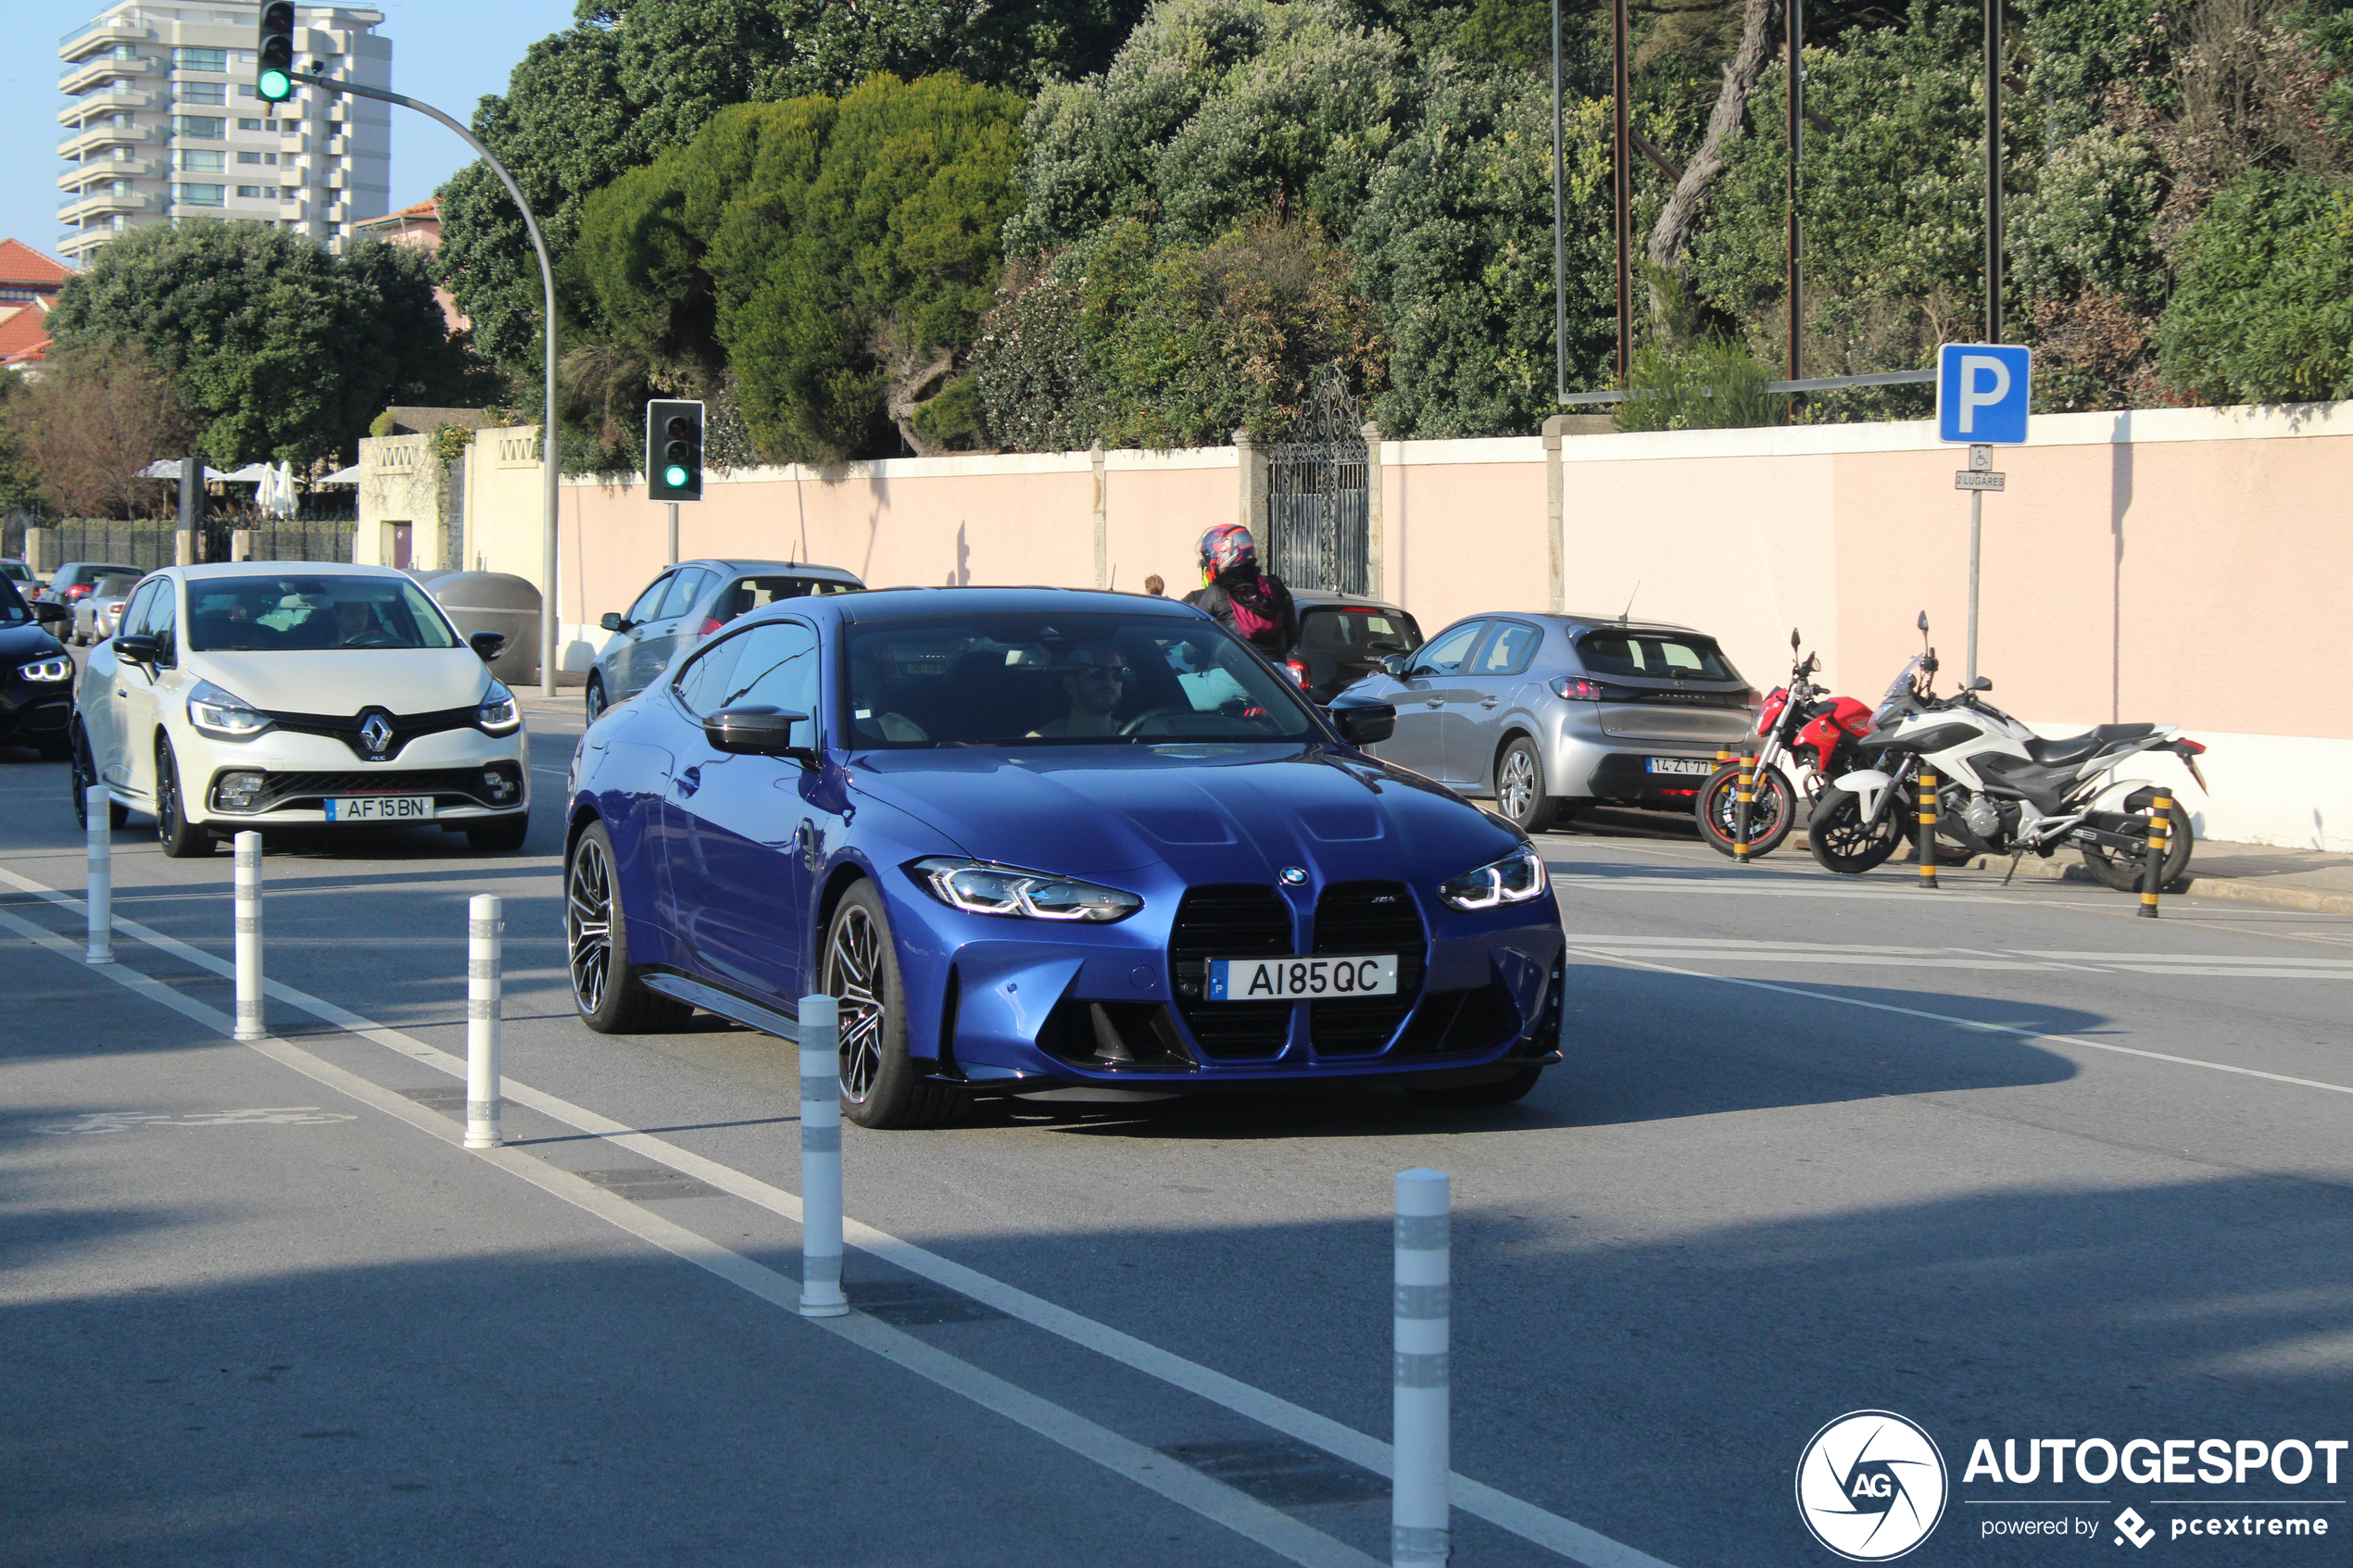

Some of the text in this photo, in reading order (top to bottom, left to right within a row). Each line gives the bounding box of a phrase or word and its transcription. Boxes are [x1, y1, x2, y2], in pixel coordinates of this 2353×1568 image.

[1958, 355, 2011, 433] P
[1957, 475, 2004, 487] 2 LUGARES
